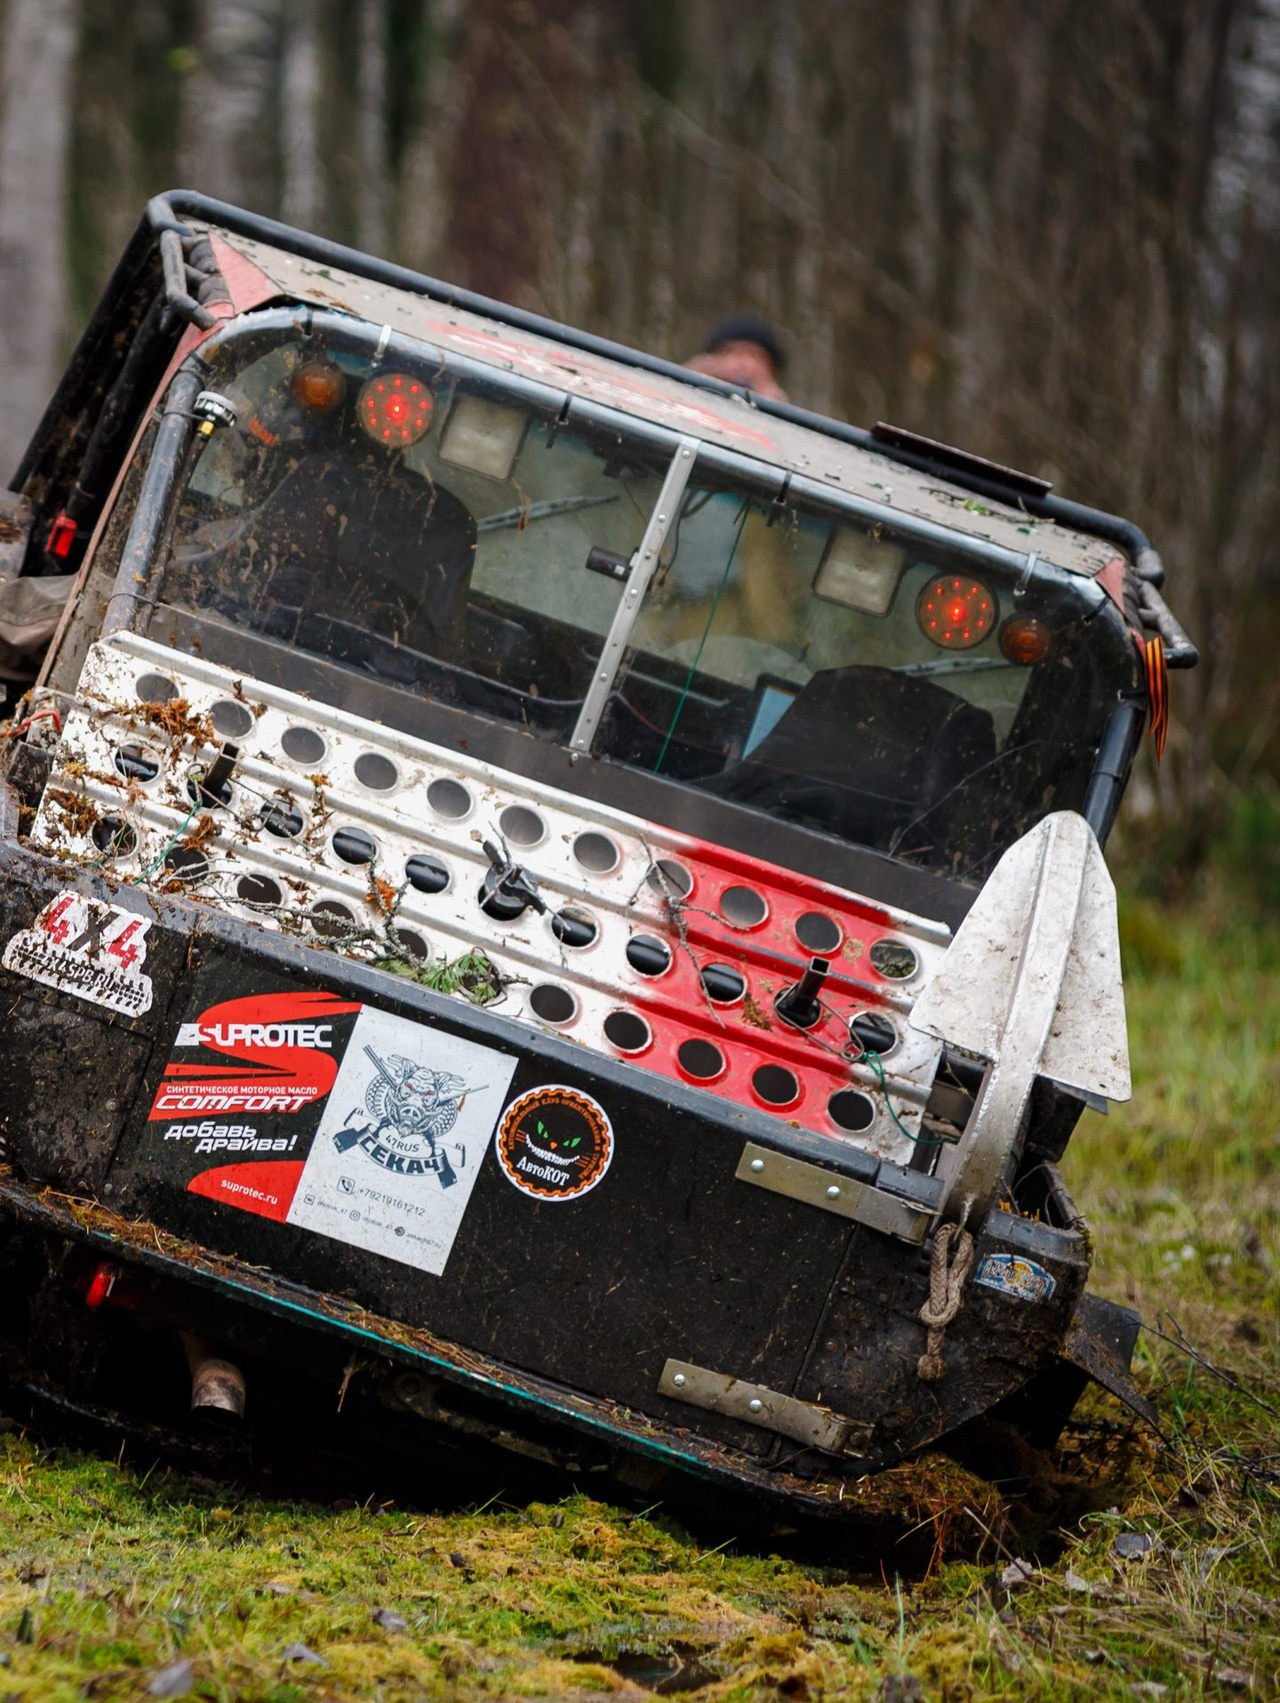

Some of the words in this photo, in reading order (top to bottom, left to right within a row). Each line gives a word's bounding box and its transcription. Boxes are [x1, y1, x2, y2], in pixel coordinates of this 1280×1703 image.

[40, 896, 143, 969] 4X4
[196, 1023, 332, 1048] SUPROTEC
[166, 1085, 238, 1095] СИНТЕТИЧЕСКОЕ
[239, 1086, 286, 1095] МОТОРНОЕ
[287, 1087, 318, 1096] МАСЛО
[155, 1095, 313, 1111] COMFORT
[163, 1121, 257, 1140] добавь
[194, 1135, 298, 1153] драйва!
[385, 1134, 420, 1153] 47RUS
[360, 1136, 440, 1174] СЕКАЧ
[220, 1179, 278, 1205] suprotec.ru
